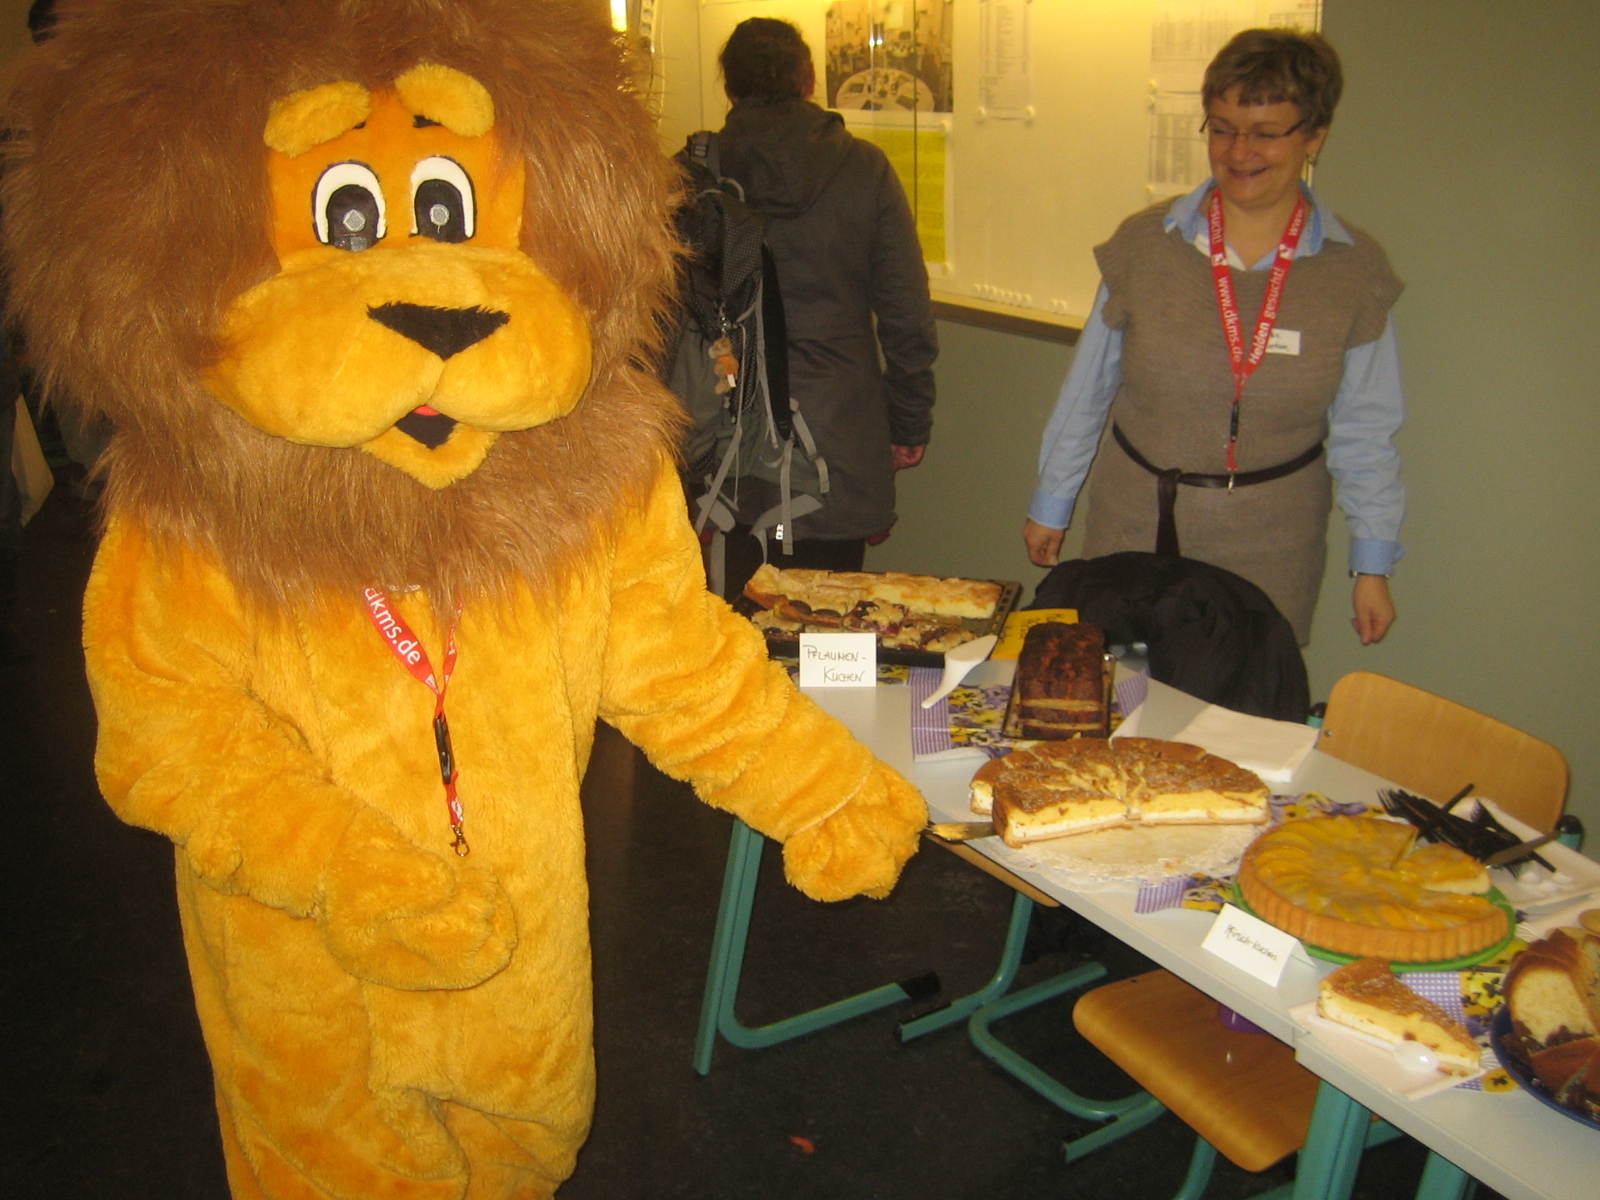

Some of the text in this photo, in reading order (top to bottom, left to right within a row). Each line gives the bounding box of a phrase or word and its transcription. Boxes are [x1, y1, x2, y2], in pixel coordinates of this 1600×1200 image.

[1217, 276, 1244, 362] www.dkms.de
[1248, 321, 1270, 364] Helden
[1264, 267, 1285, 320] gesucht!
